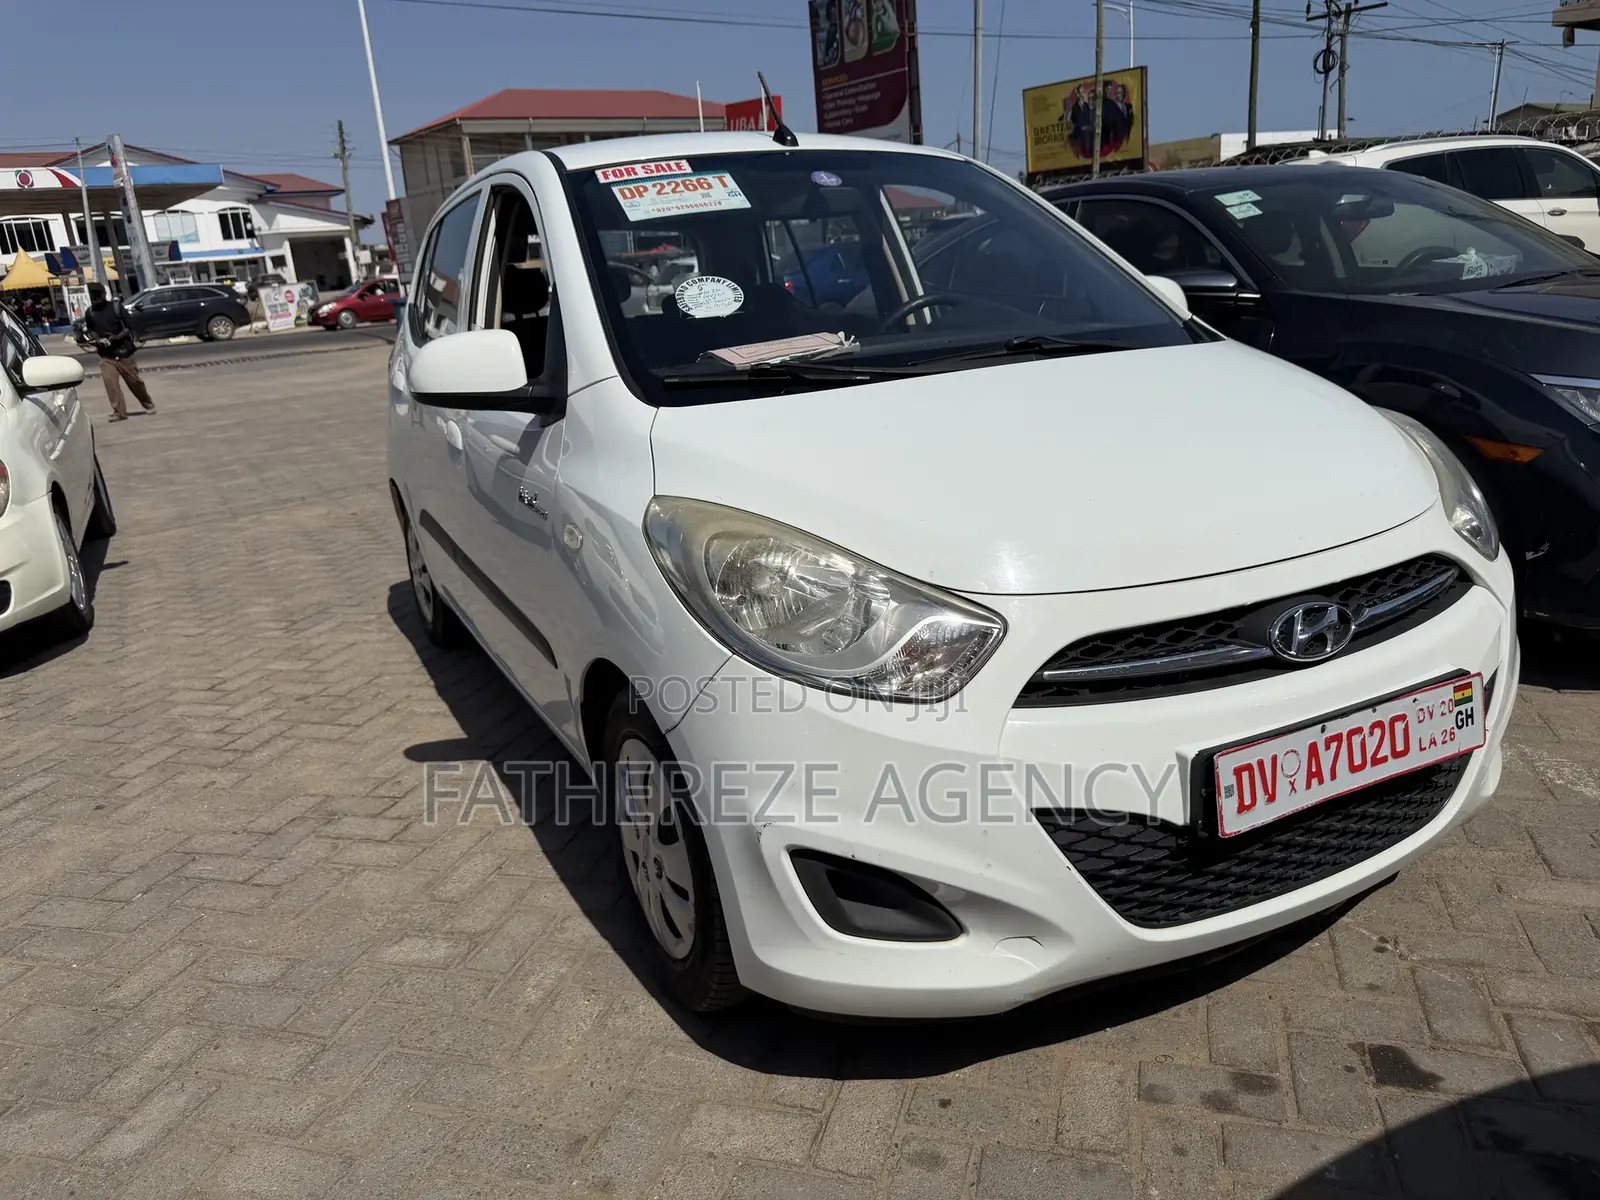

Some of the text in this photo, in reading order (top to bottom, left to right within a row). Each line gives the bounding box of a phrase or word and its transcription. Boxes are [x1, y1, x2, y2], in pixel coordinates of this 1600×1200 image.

[601, 161, 687, 181] FOR SALE
[617, 184, 649, 201] DP
[652, 176, 713, 196] 2266
[712, 175, 729, 189] T
[686, 277, 728, 287] COMPANY
[726, 282, 743, 303] LIMITED
[1417, 698, 1455, 724] DV 20
[1455, 706, 1475, 731] GH
[1419, 727, 1456, 752] LA 26
[1233, 713, 1411, 815] DV A7020
